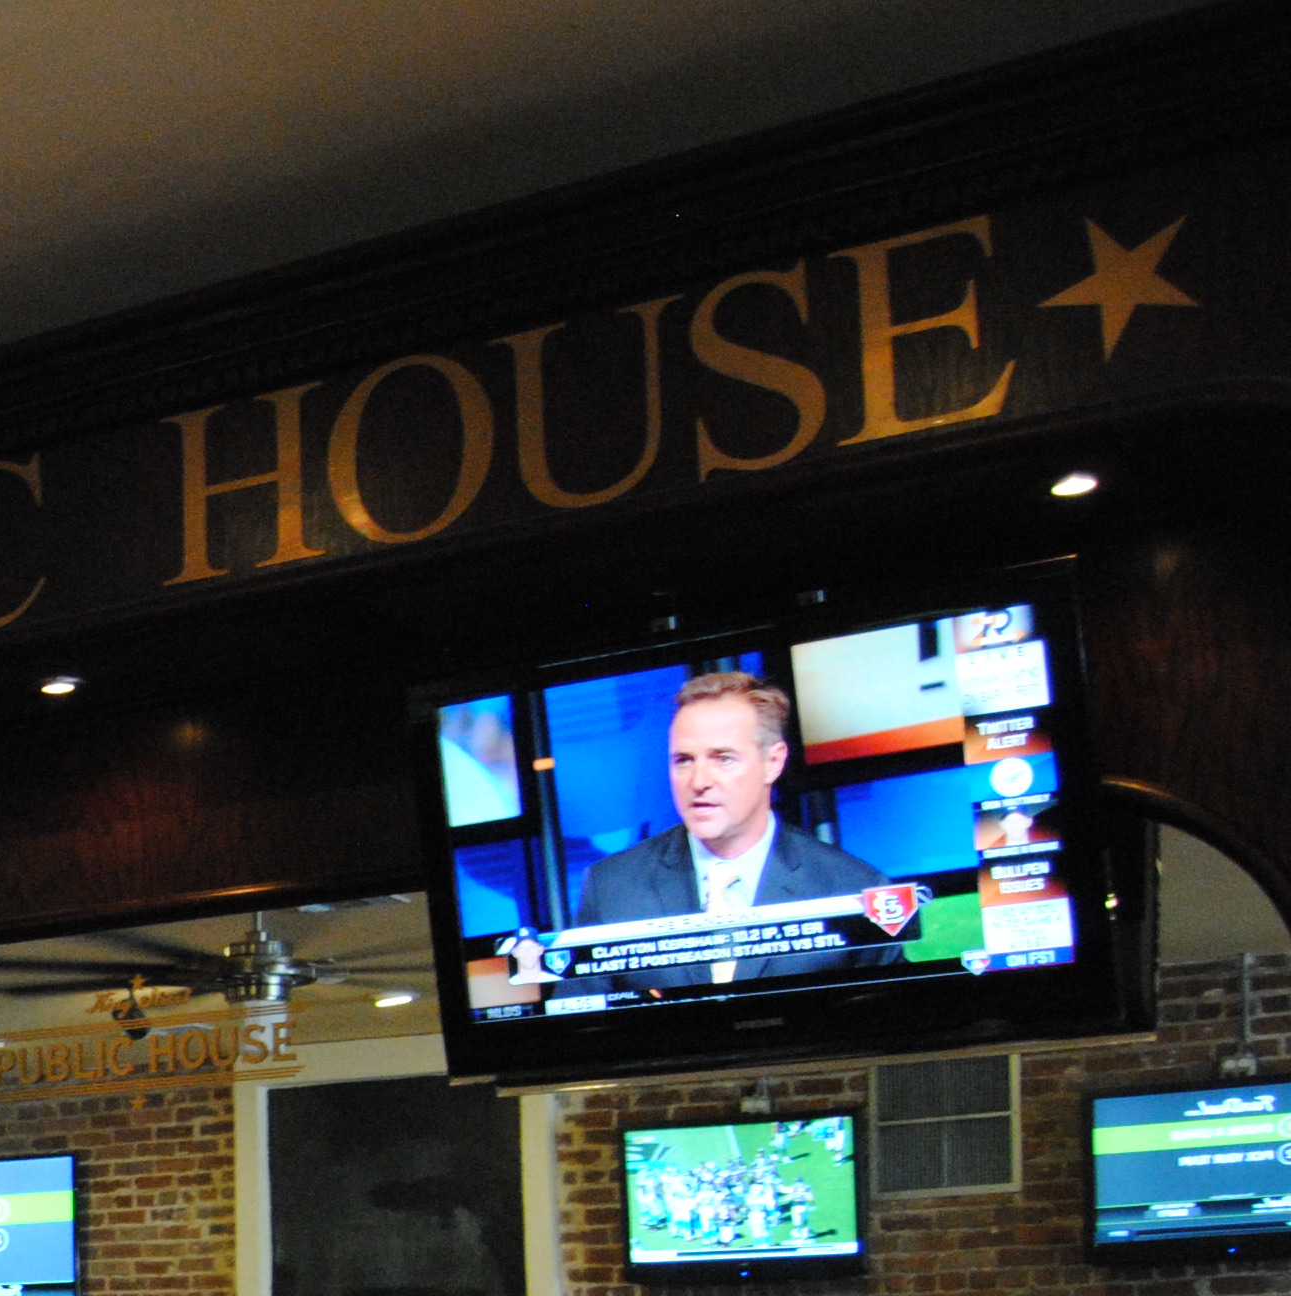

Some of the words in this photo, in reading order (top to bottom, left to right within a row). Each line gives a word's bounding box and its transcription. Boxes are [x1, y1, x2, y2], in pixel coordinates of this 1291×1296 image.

[160, 214, 1017, 587] HOUSE
[575, 962, 591, 975] IN
[592, 958, 628, 973] LAST
[629, 956, 640, 969] 2
[641, 947, 731, 968] POSTSEASON
[732, 941, 790, 958] STARTS
[791, 937, 814, 950] VS
[814, 934, 846, 948] STL
[592, 940, 656, 959] CLAYTON
[148, 1019, 298, 1073] HOUSE
